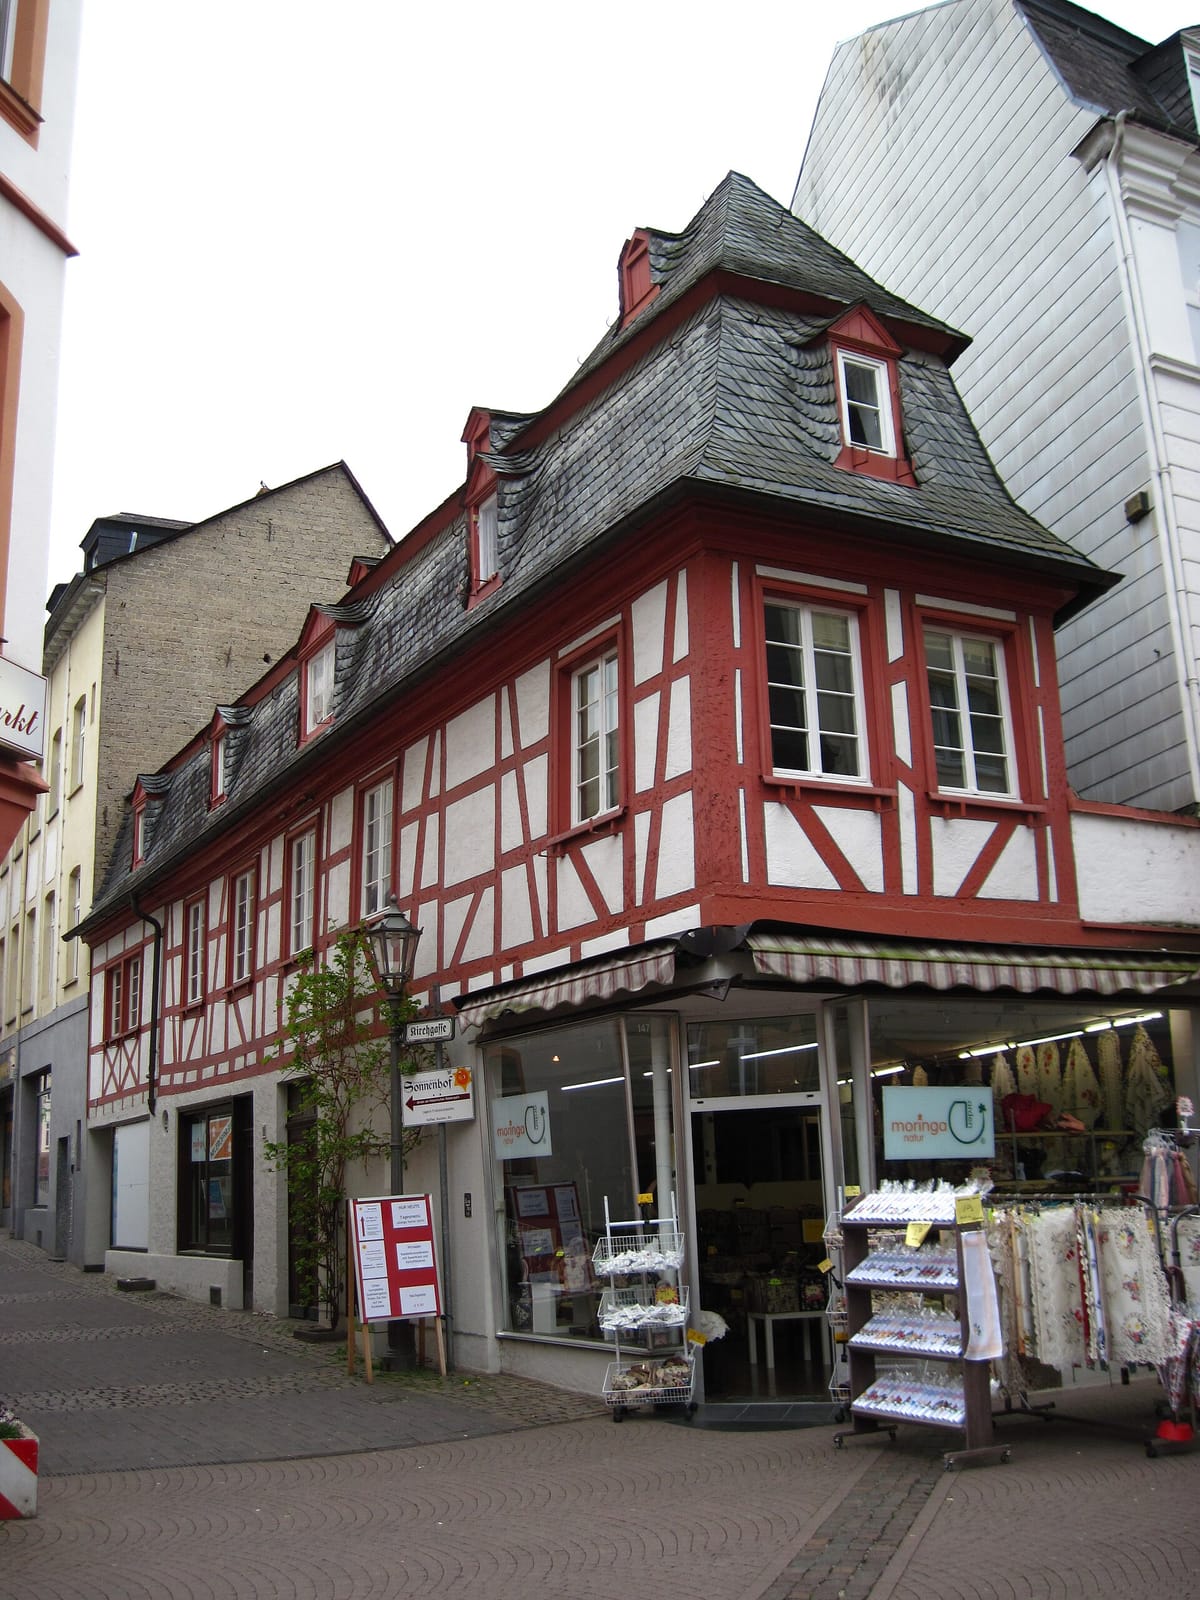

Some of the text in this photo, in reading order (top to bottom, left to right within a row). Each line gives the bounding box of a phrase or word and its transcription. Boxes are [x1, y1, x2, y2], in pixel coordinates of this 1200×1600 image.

[0, 704, 39, 736] rkt
[404, 1075, 453, 1093] Sonnenhof
[497, 1120, 525, 1138] moringa
[891, 1113, 947, 1135] moringa
